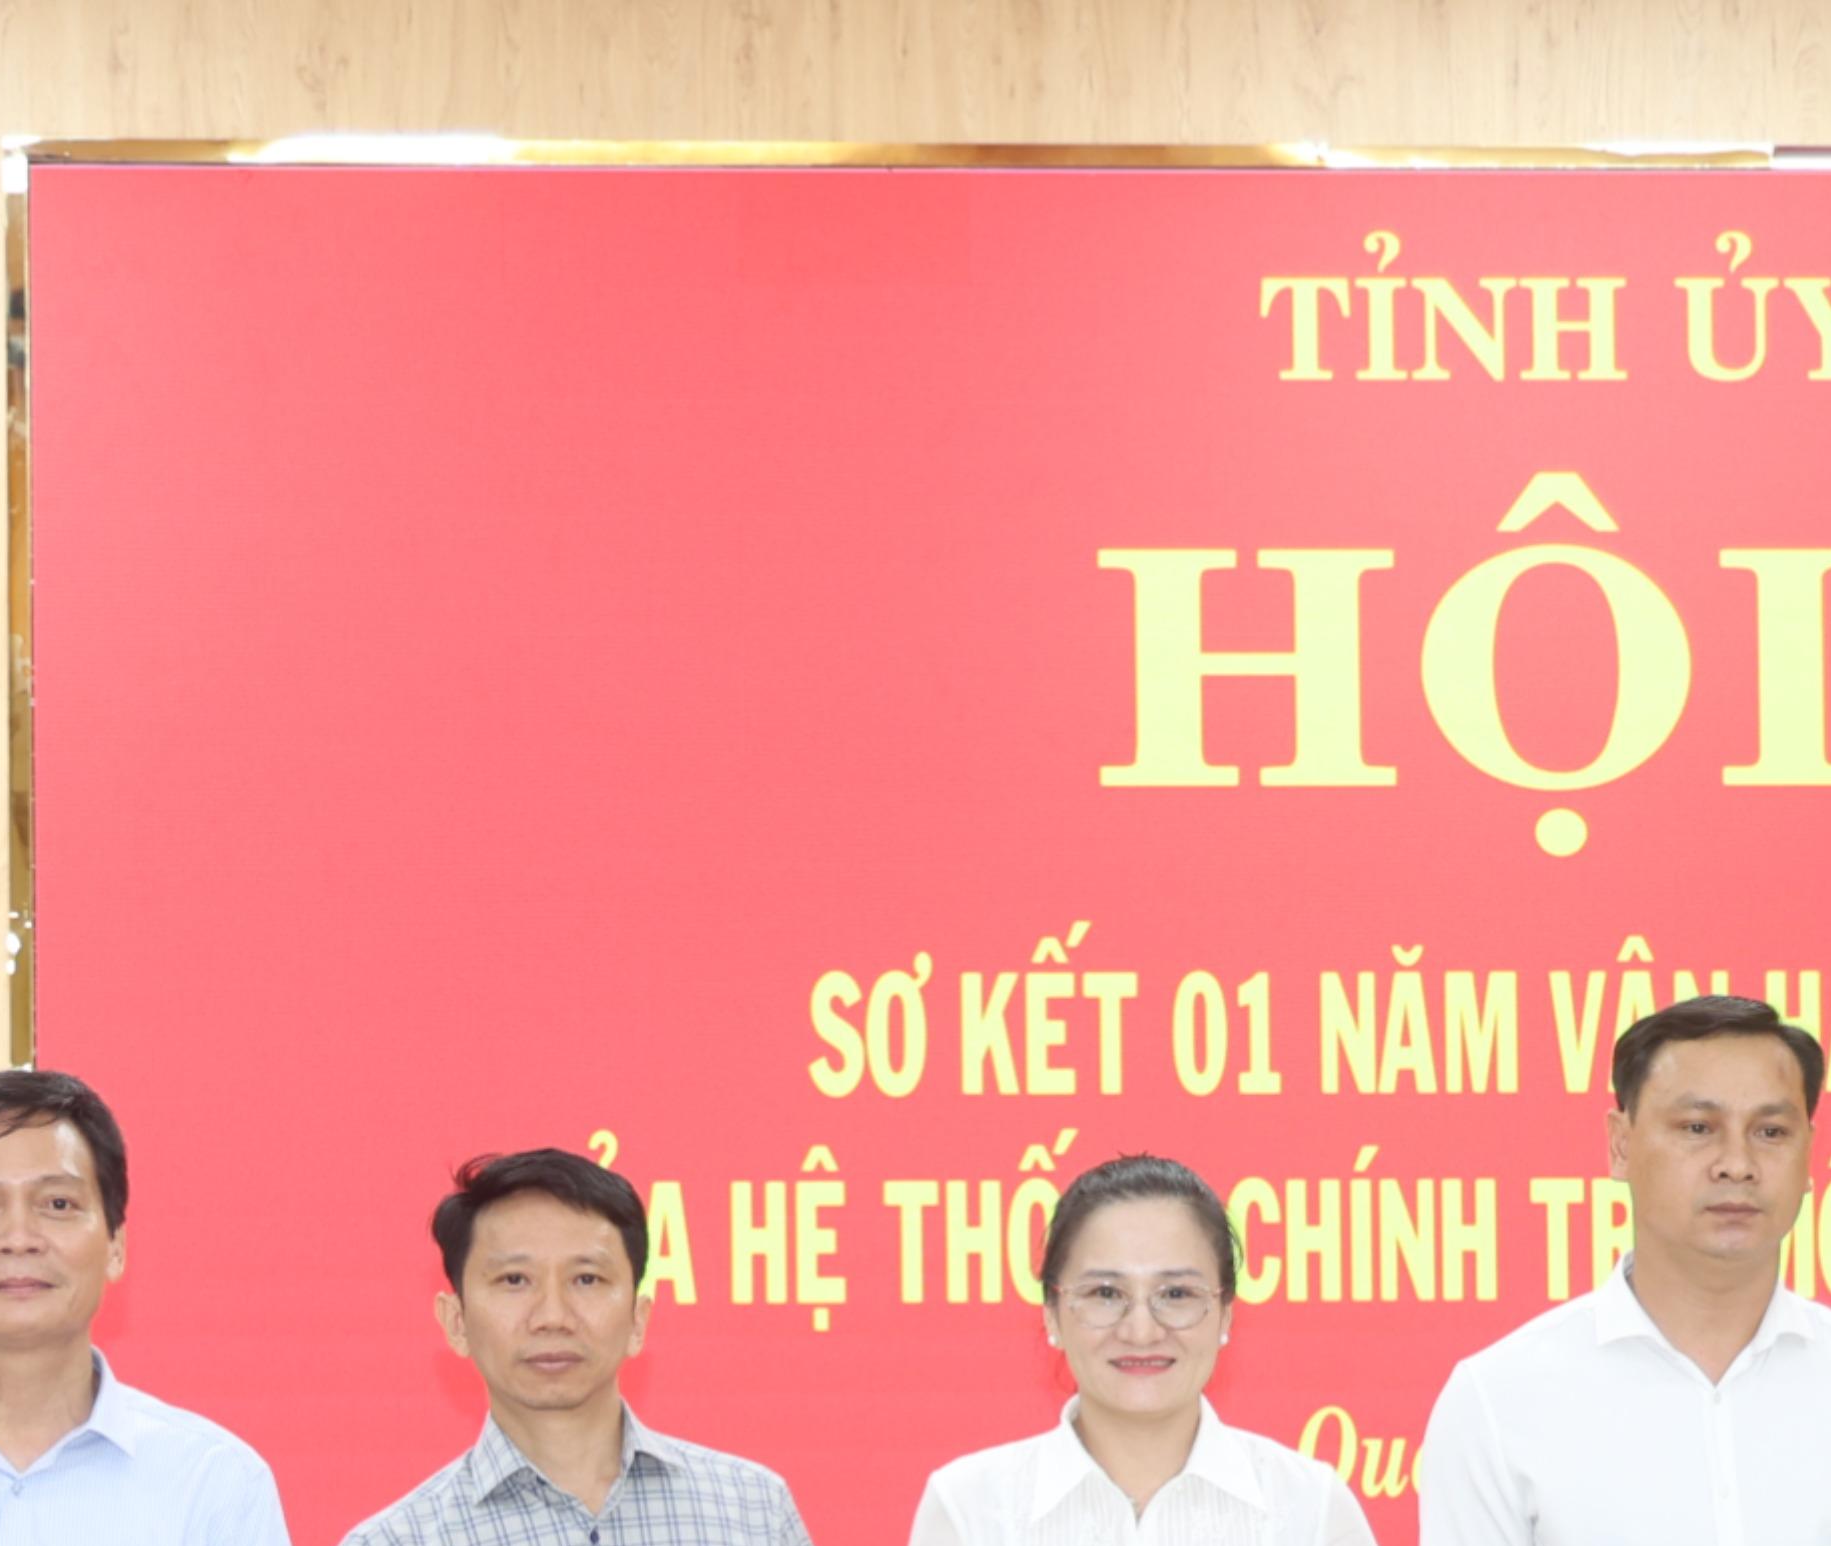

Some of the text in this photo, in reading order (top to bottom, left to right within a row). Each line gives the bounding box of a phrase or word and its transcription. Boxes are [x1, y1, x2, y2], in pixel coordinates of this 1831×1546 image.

[1259, 230, 1629, 382] TỈNH
[808, 951, 933, 1098] SƠ
[960, 920, 1138, 1095] KẾT
[1172, 970, 1282, 1096] 01
[1320, 944, 1519, 1094] NĂM
[730, 1145, 847, 1332] HỆ
[883, 1128, 1058, 1305] THỐ
[1226, 1145, 1498, 1303] CHÍNH
[1529, 1177, 1636, 1301] TR
